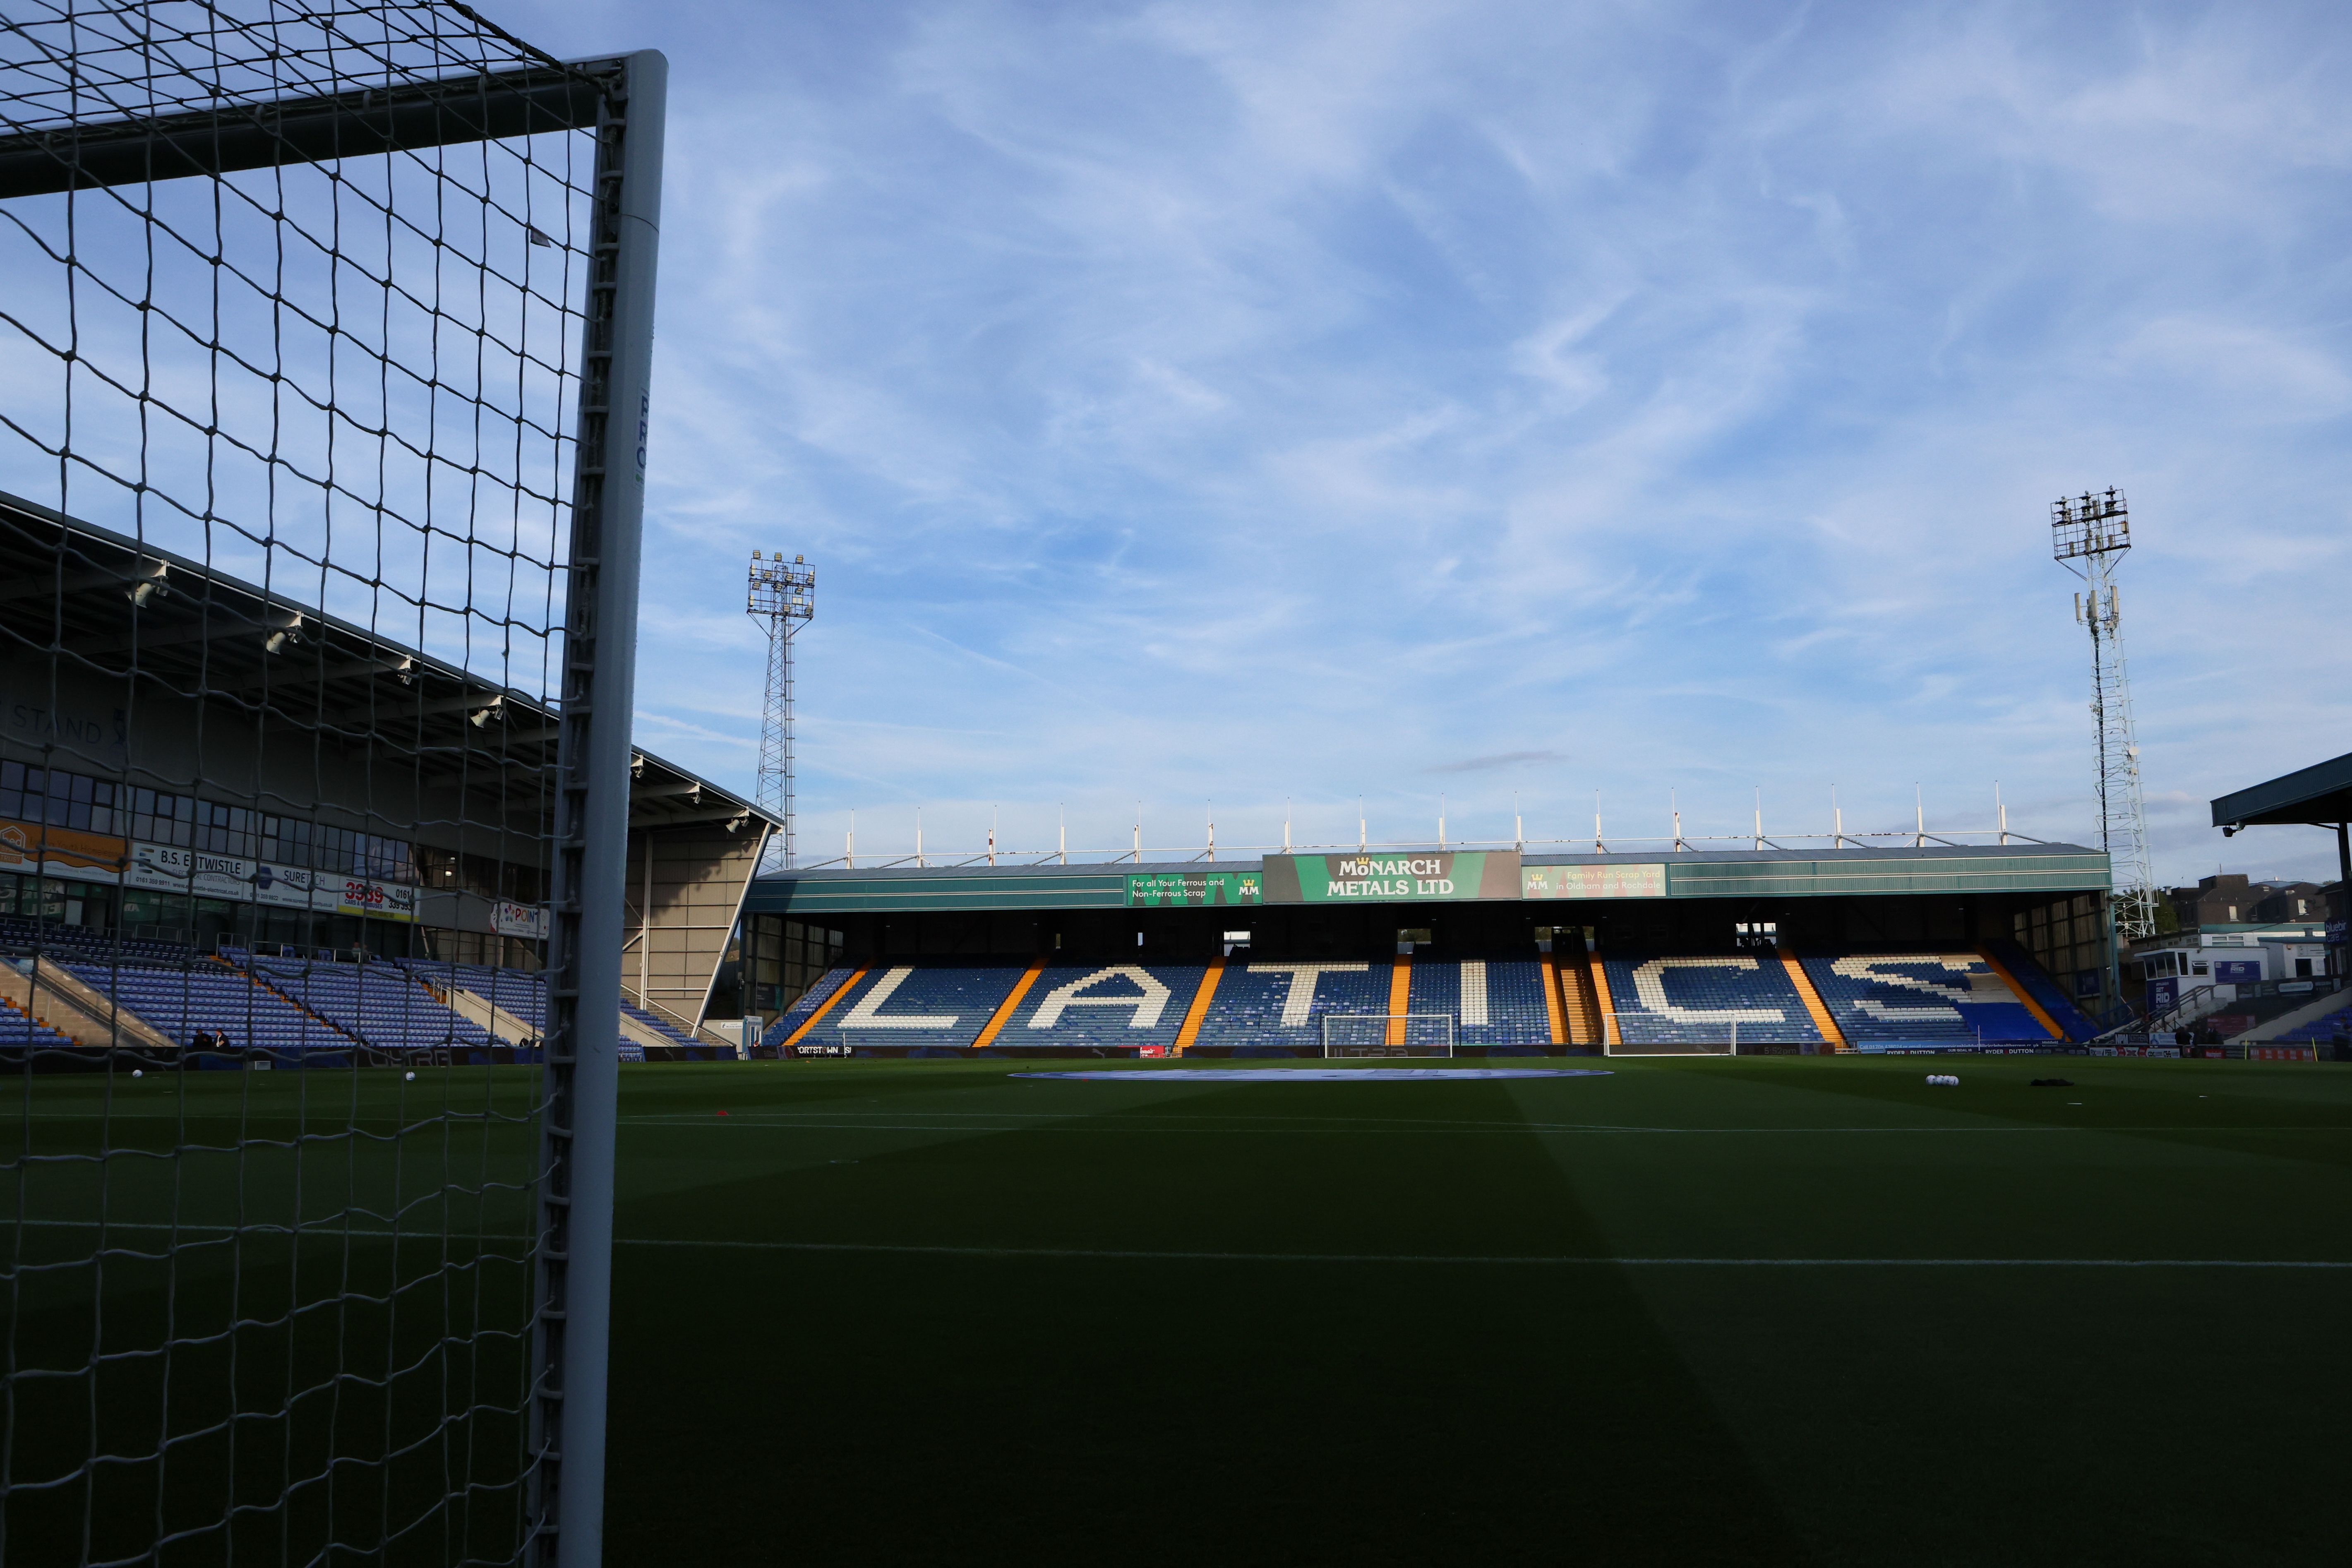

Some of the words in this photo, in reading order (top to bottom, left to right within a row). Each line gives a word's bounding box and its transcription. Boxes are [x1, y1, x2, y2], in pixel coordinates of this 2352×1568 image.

[13, 705, 101, 744] STAND
[161, 850, 180, 865] B.S.
[184, 855, 241, 874] ETWISTLE
[1339, 860, 1441, 876] MONARCH
[284, 870, 325, 886] SURETCH
[1567, 872, 1594, 881] Family
[1615, 871, 1639, 880] Scrap
[173, 883, 239, 896] www.ewistle-electrical.co.uk
[1238, 886, 1259, 895] MM
[1327, 880, 1409, 896] METALS
[1417, 879, 1454, 895] LTD
[1527, 881, 1548, 890] MM
[396, 889, 410, 899] 0161
[1183, 890, 1206, 898] Scrap
[2156, 992, 2170, 1004] RID
